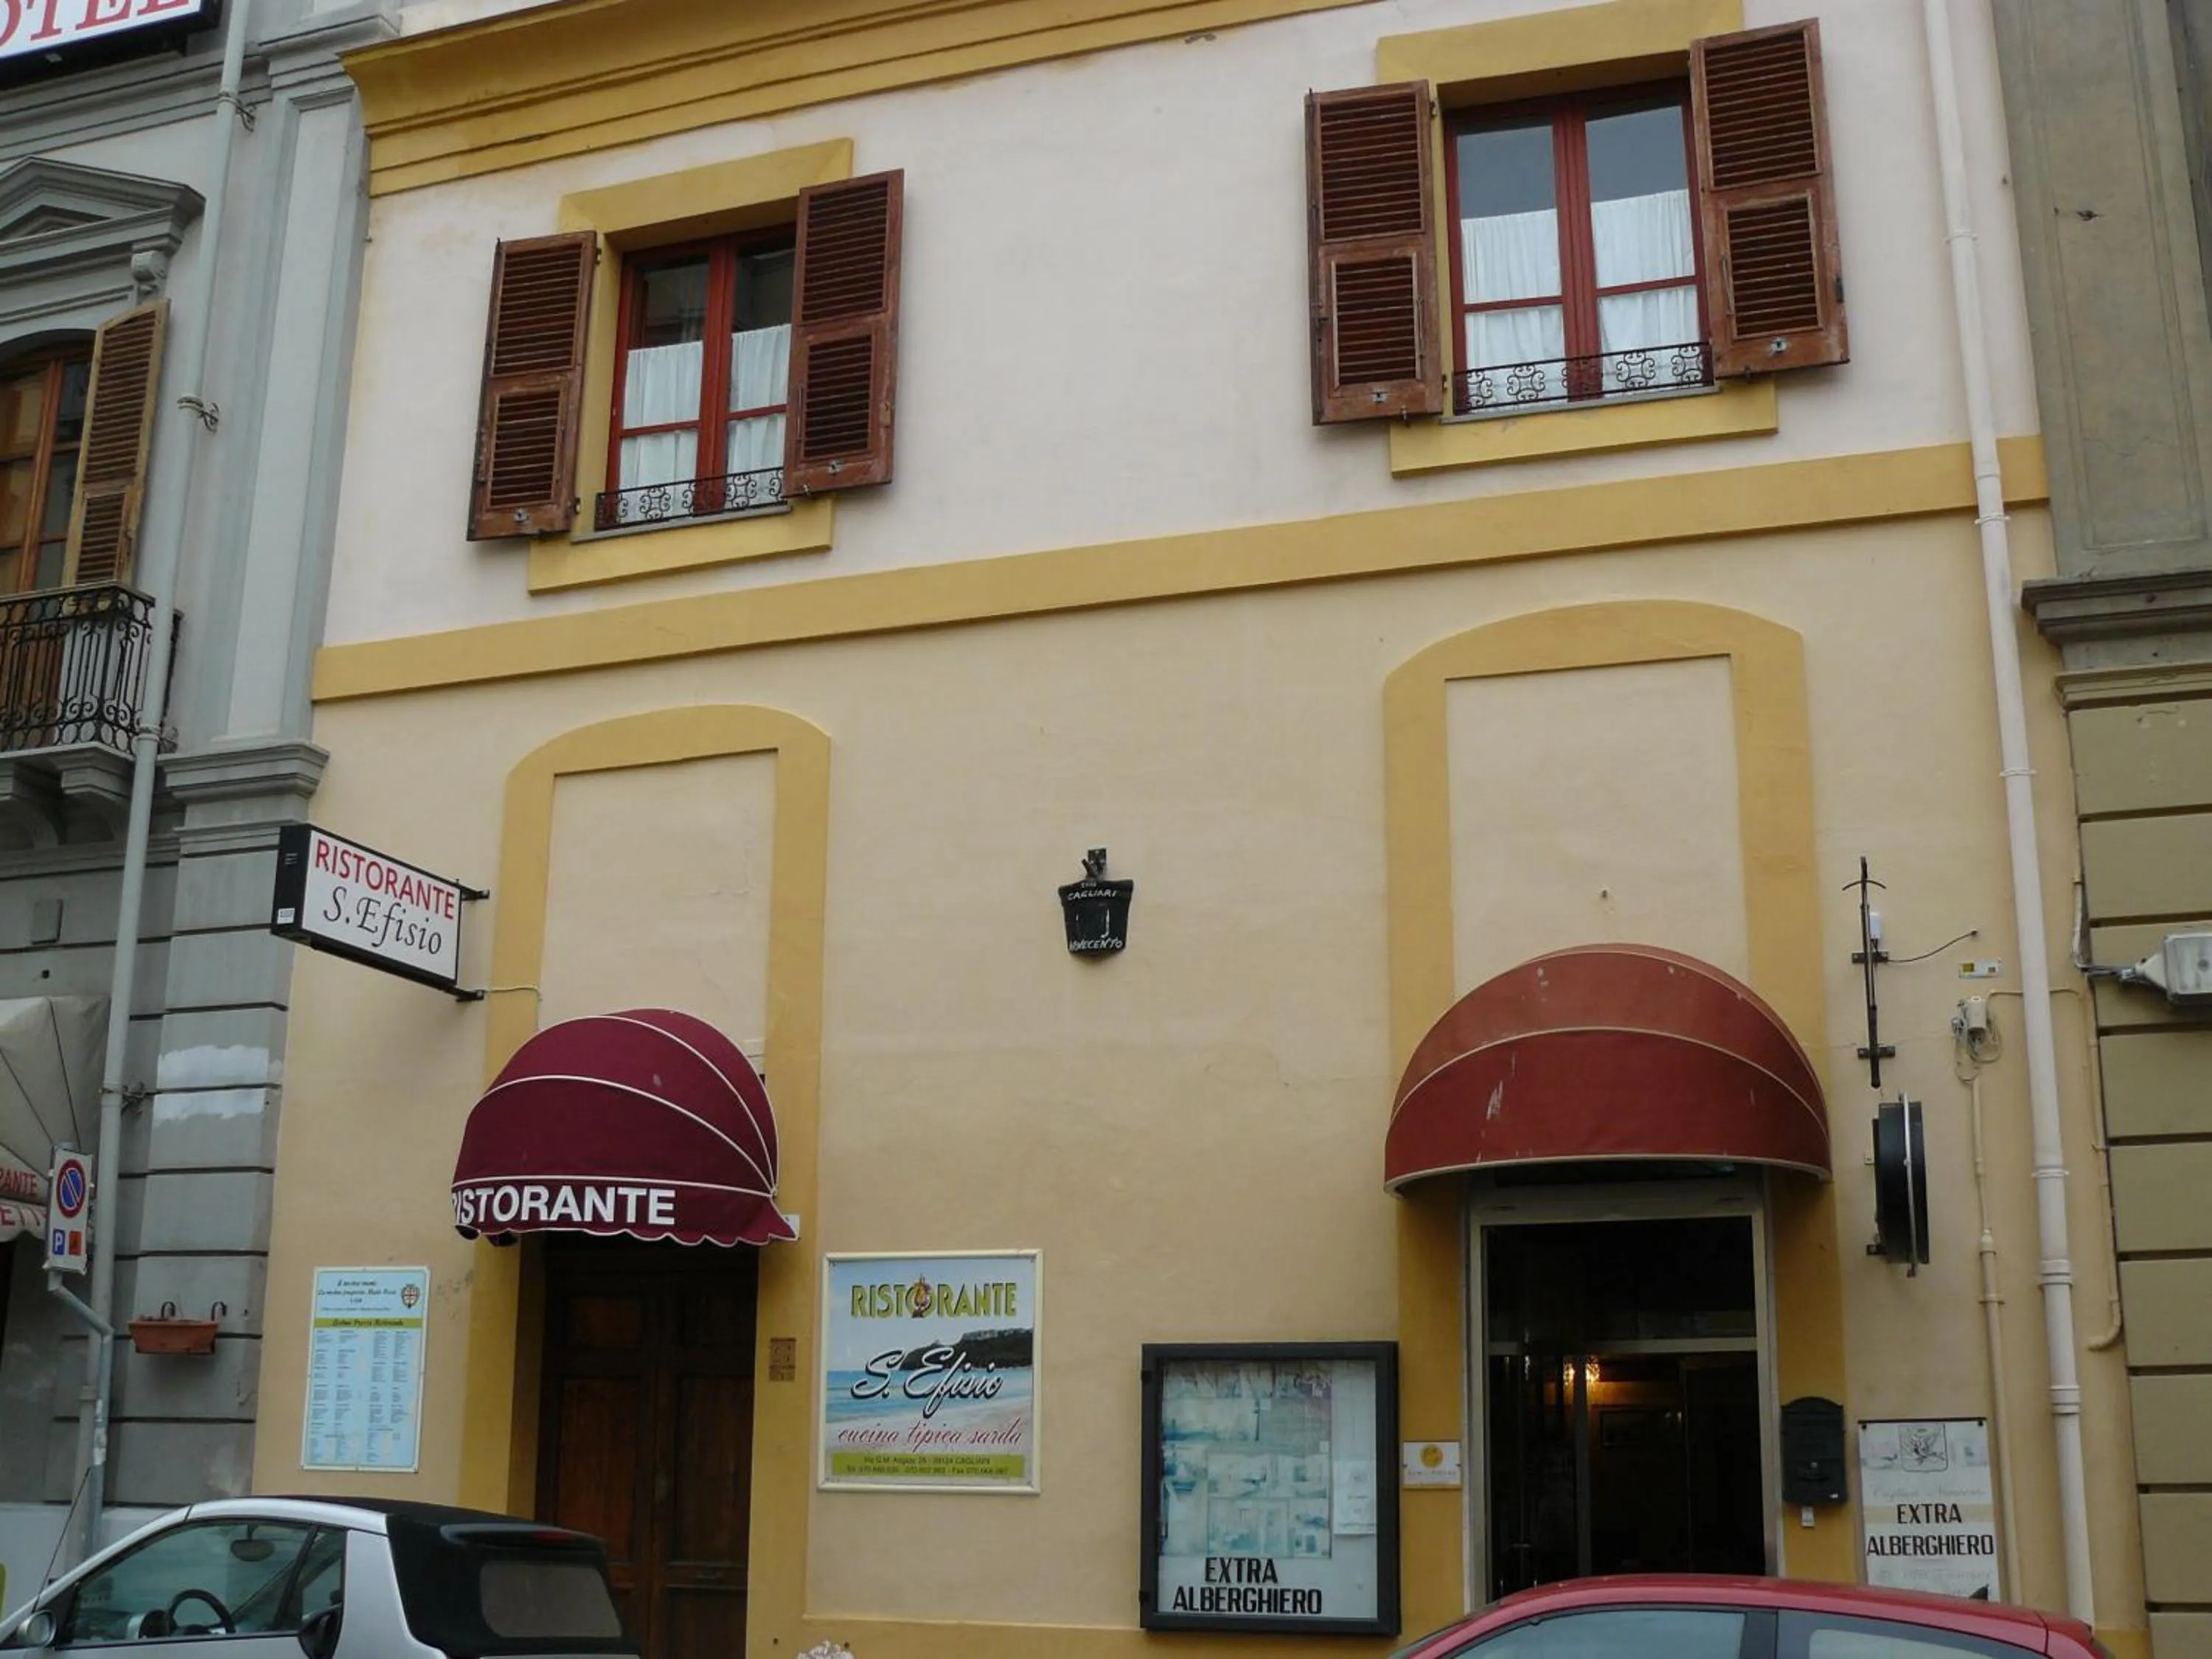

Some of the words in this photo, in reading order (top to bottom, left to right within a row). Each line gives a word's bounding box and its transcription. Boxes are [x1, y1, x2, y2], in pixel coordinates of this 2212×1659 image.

[315, 839, 455, 919] RISTORANTE
[1068, 889, 1119, 900] CAGLIARI
[851, 1281, 1017, 1318] RISTORANTE
[838, 1422, 899, 1443] cucina
[908, 1419, 962, 1453] tipica
[968, 1416, 1022, 1444] sarda
[1896, 1503, 1962, 1524] EXTRA
[1866, 1534, 1994, 1557] ALBERGHIERO
[1204, 1557, 1278, 1584] EXTRA
[1173, 1585, 1322, 1614] ALBERGHIERO
